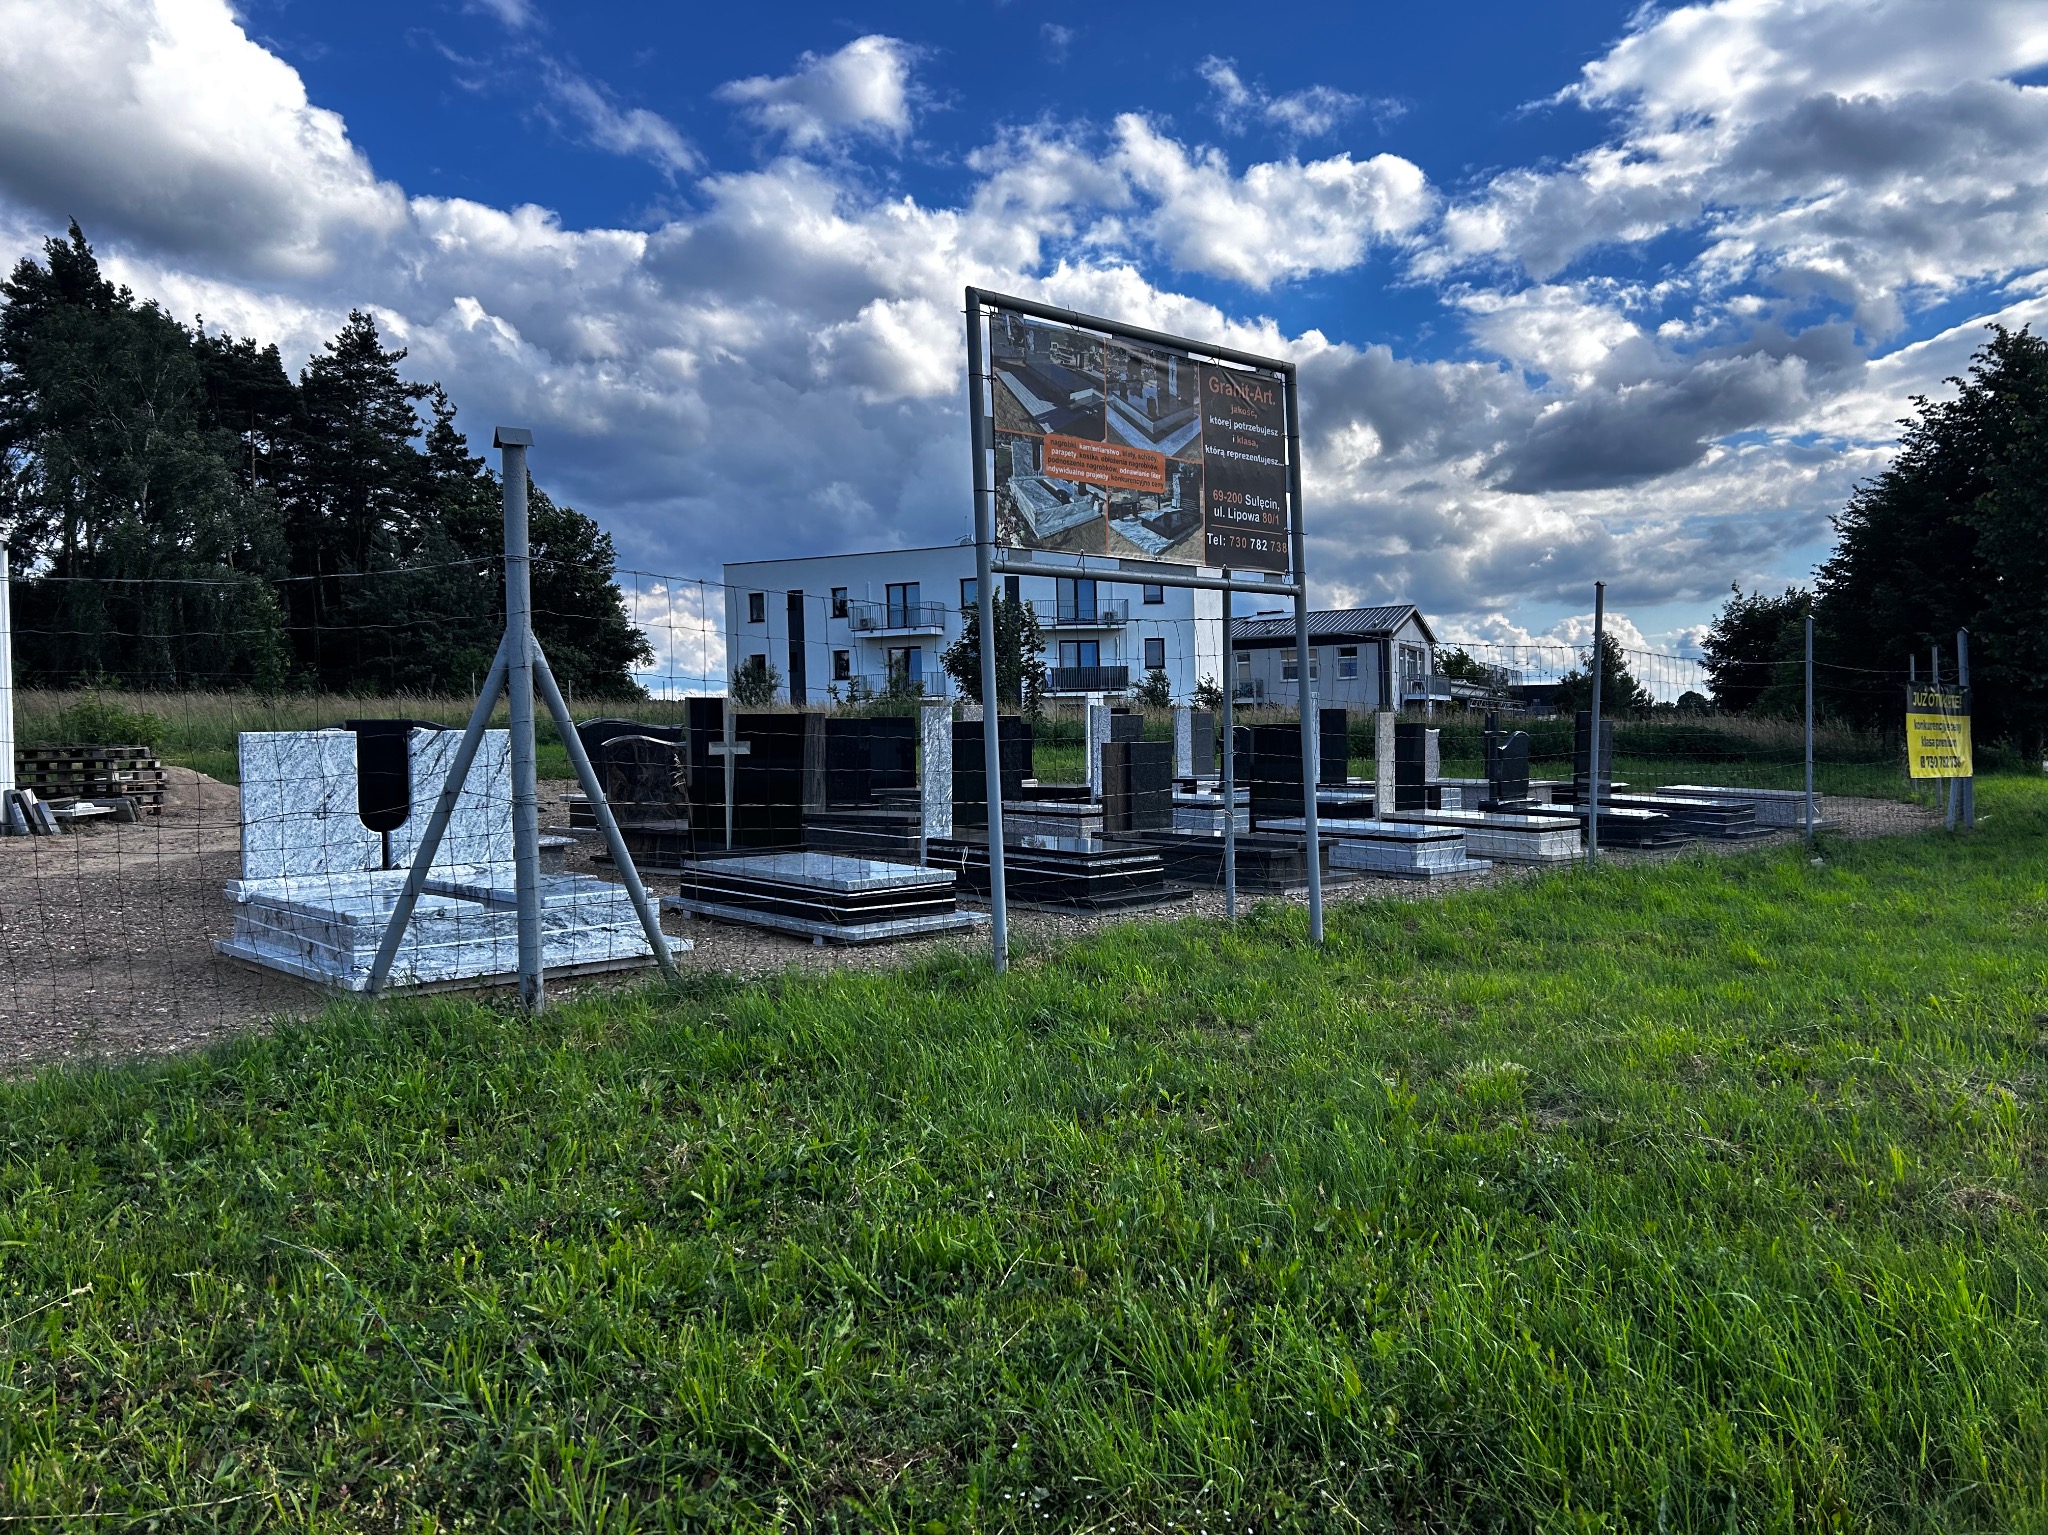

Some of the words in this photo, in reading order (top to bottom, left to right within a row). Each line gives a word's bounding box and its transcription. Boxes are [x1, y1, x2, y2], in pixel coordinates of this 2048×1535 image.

[1209, 415, 1232, 429] której
[1234, 421, 1278, 436] potrzebujesz
[1205, 445, 1225, 458] którą
[1236, 436, 1258, 448] klasa,
[1213, 489, 1243, 504] 69-200
[1245, 494, 1280, 511] Sulęcin,
[1214, 506, 1225, 517] ul.
[1228, 507, 1260, 522] Lipowa
[1263, 513, 1279, 525] 80/1
[1207, 533, 1226, 546] Tel:
[1230, 536, 1247, 548] 730
[1250, 538, 1267, 551] 782
[1270, 541, 1287, 553] 738
